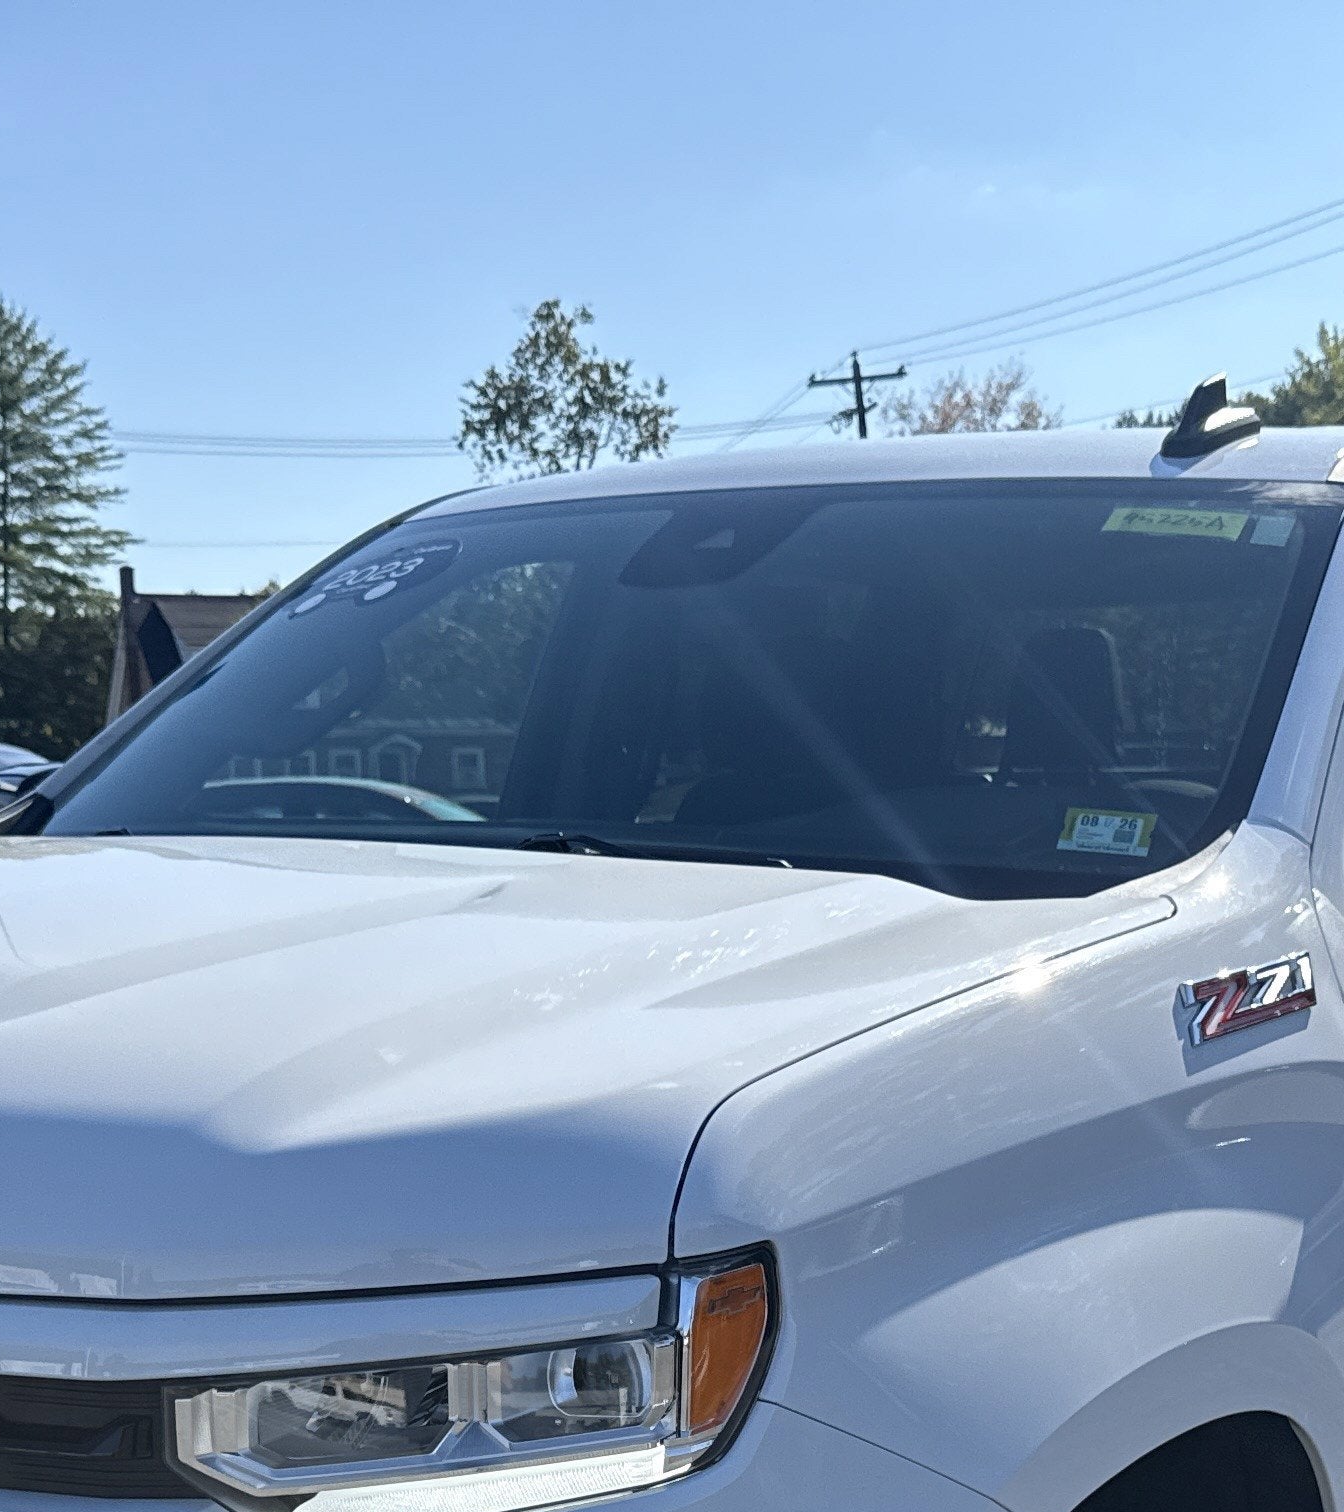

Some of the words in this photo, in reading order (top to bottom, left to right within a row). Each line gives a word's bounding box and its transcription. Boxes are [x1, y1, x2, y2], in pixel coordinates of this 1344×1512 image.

[322, 556, 425, 591] 2023
[1080, 814, 1100, 828] 08
[1119, 817, 1138, 831] 26
[1178, 950, 1317, 1048] Z71
